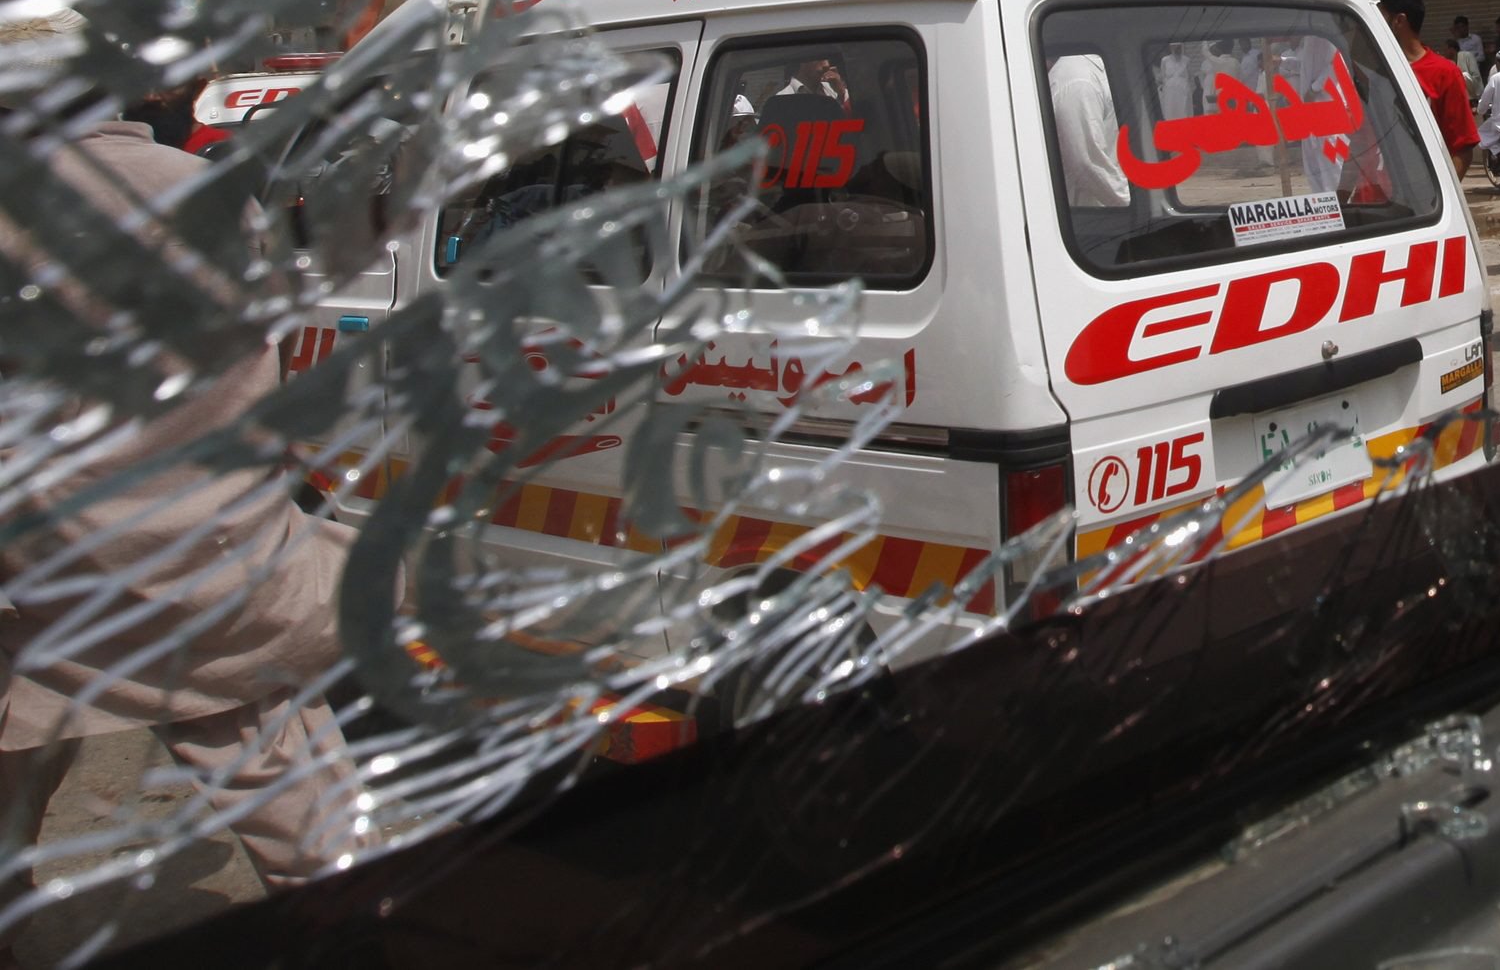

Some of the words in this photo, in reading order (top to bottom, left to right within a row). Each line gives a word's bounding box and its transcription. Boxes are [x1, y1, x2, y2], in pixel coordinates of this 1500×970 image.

[784, 118, 865, 189] 115
[1115, 49, 1364, 191] ایدھی
[1230, 197, 1314, 226] MARGALLA
[1313, 204, 1340, 215] MOTORS
[1063, 234, 1468, 386] EDHI
[1132, 431, 1206, 507] 115
